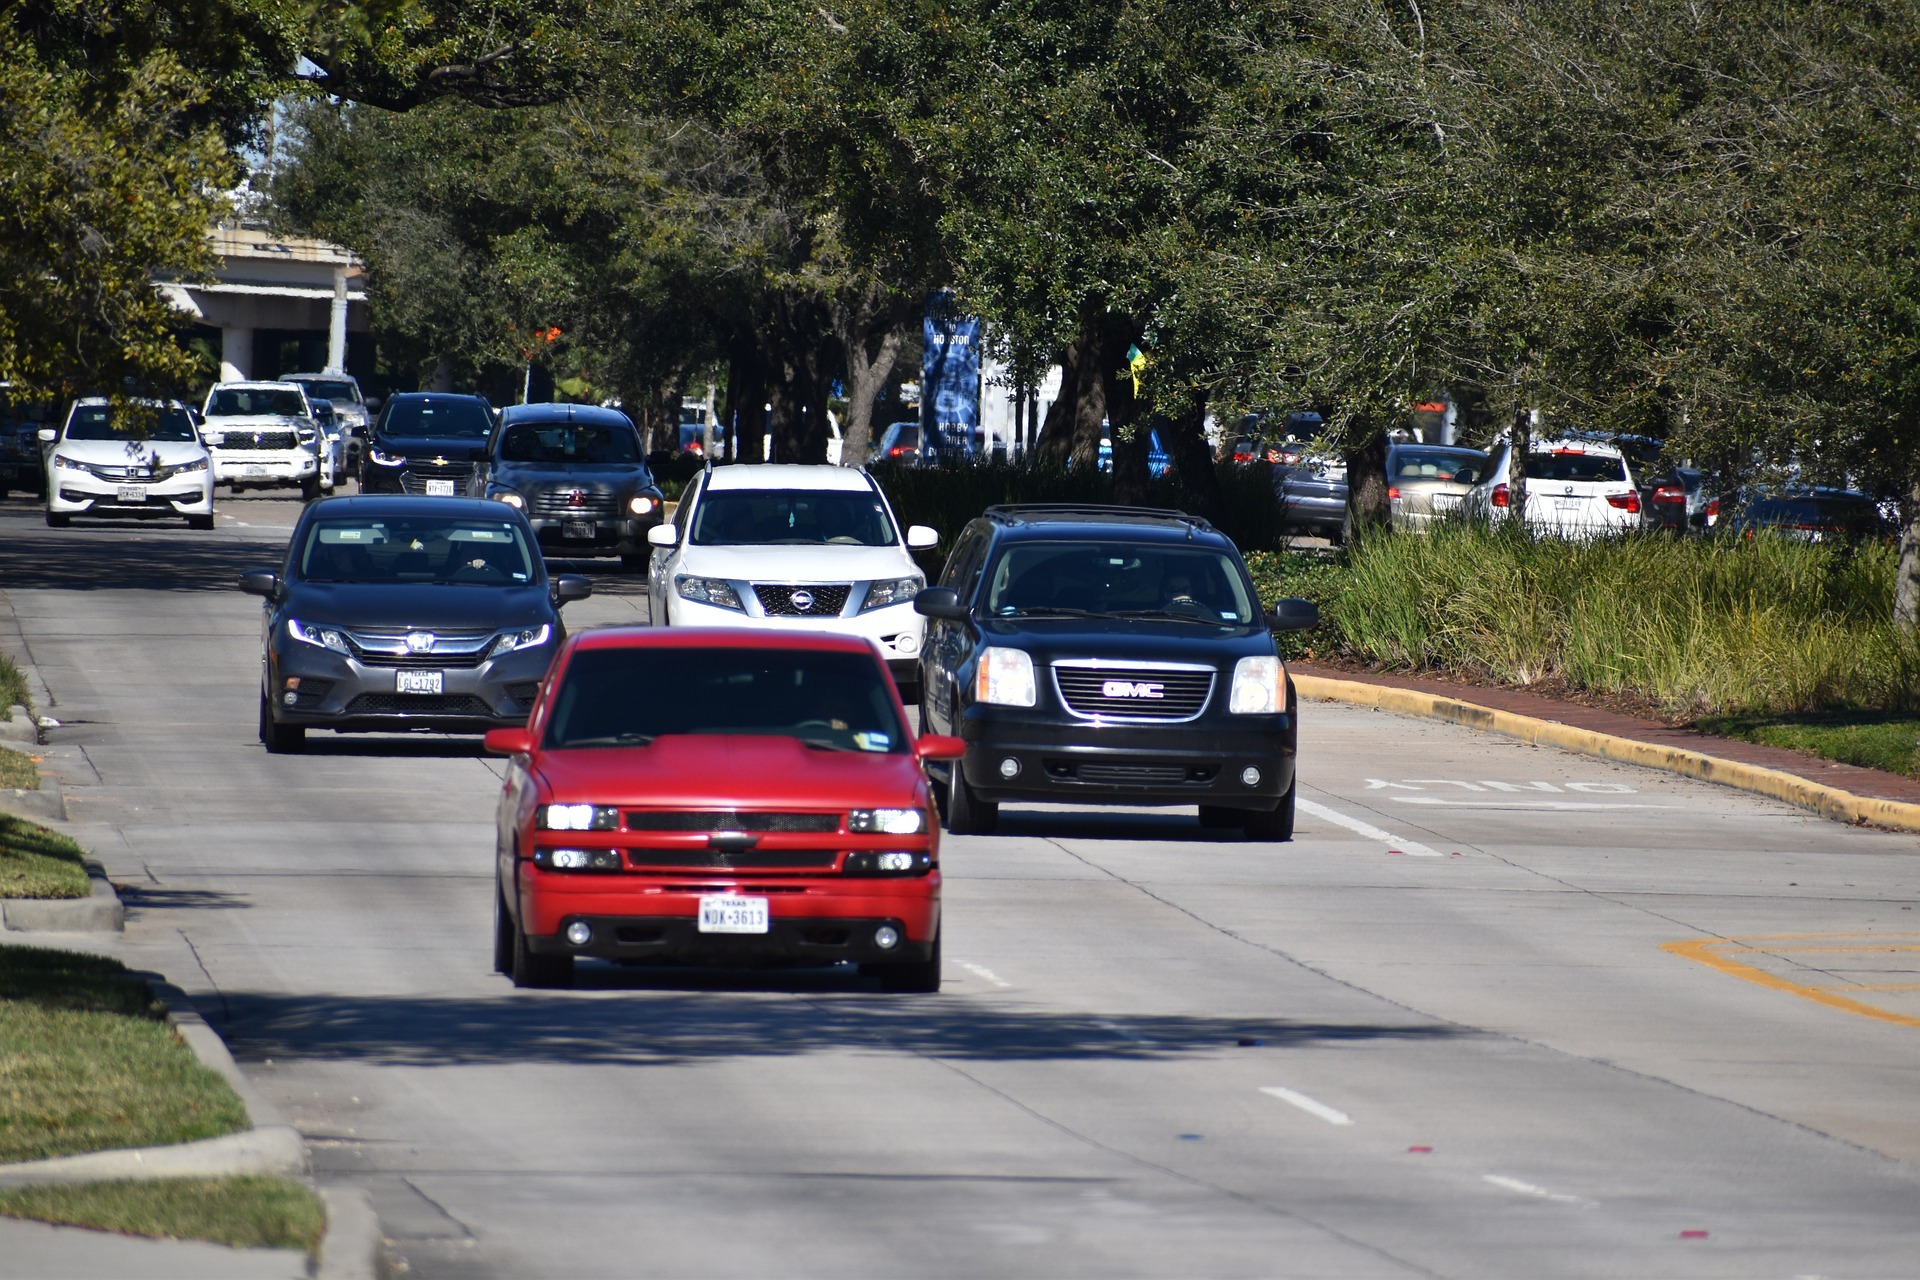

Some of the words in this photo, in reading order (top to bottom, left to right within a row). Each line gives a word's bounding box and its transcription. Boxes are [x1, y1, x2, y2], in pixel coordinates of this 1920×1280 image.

[933, 334, 970, 345] HOUSTON
[939, 422, 969, 432] HOBBY
[946, 436, 967, 445] AREA
[1103, 681, 1164, 698] GMC
